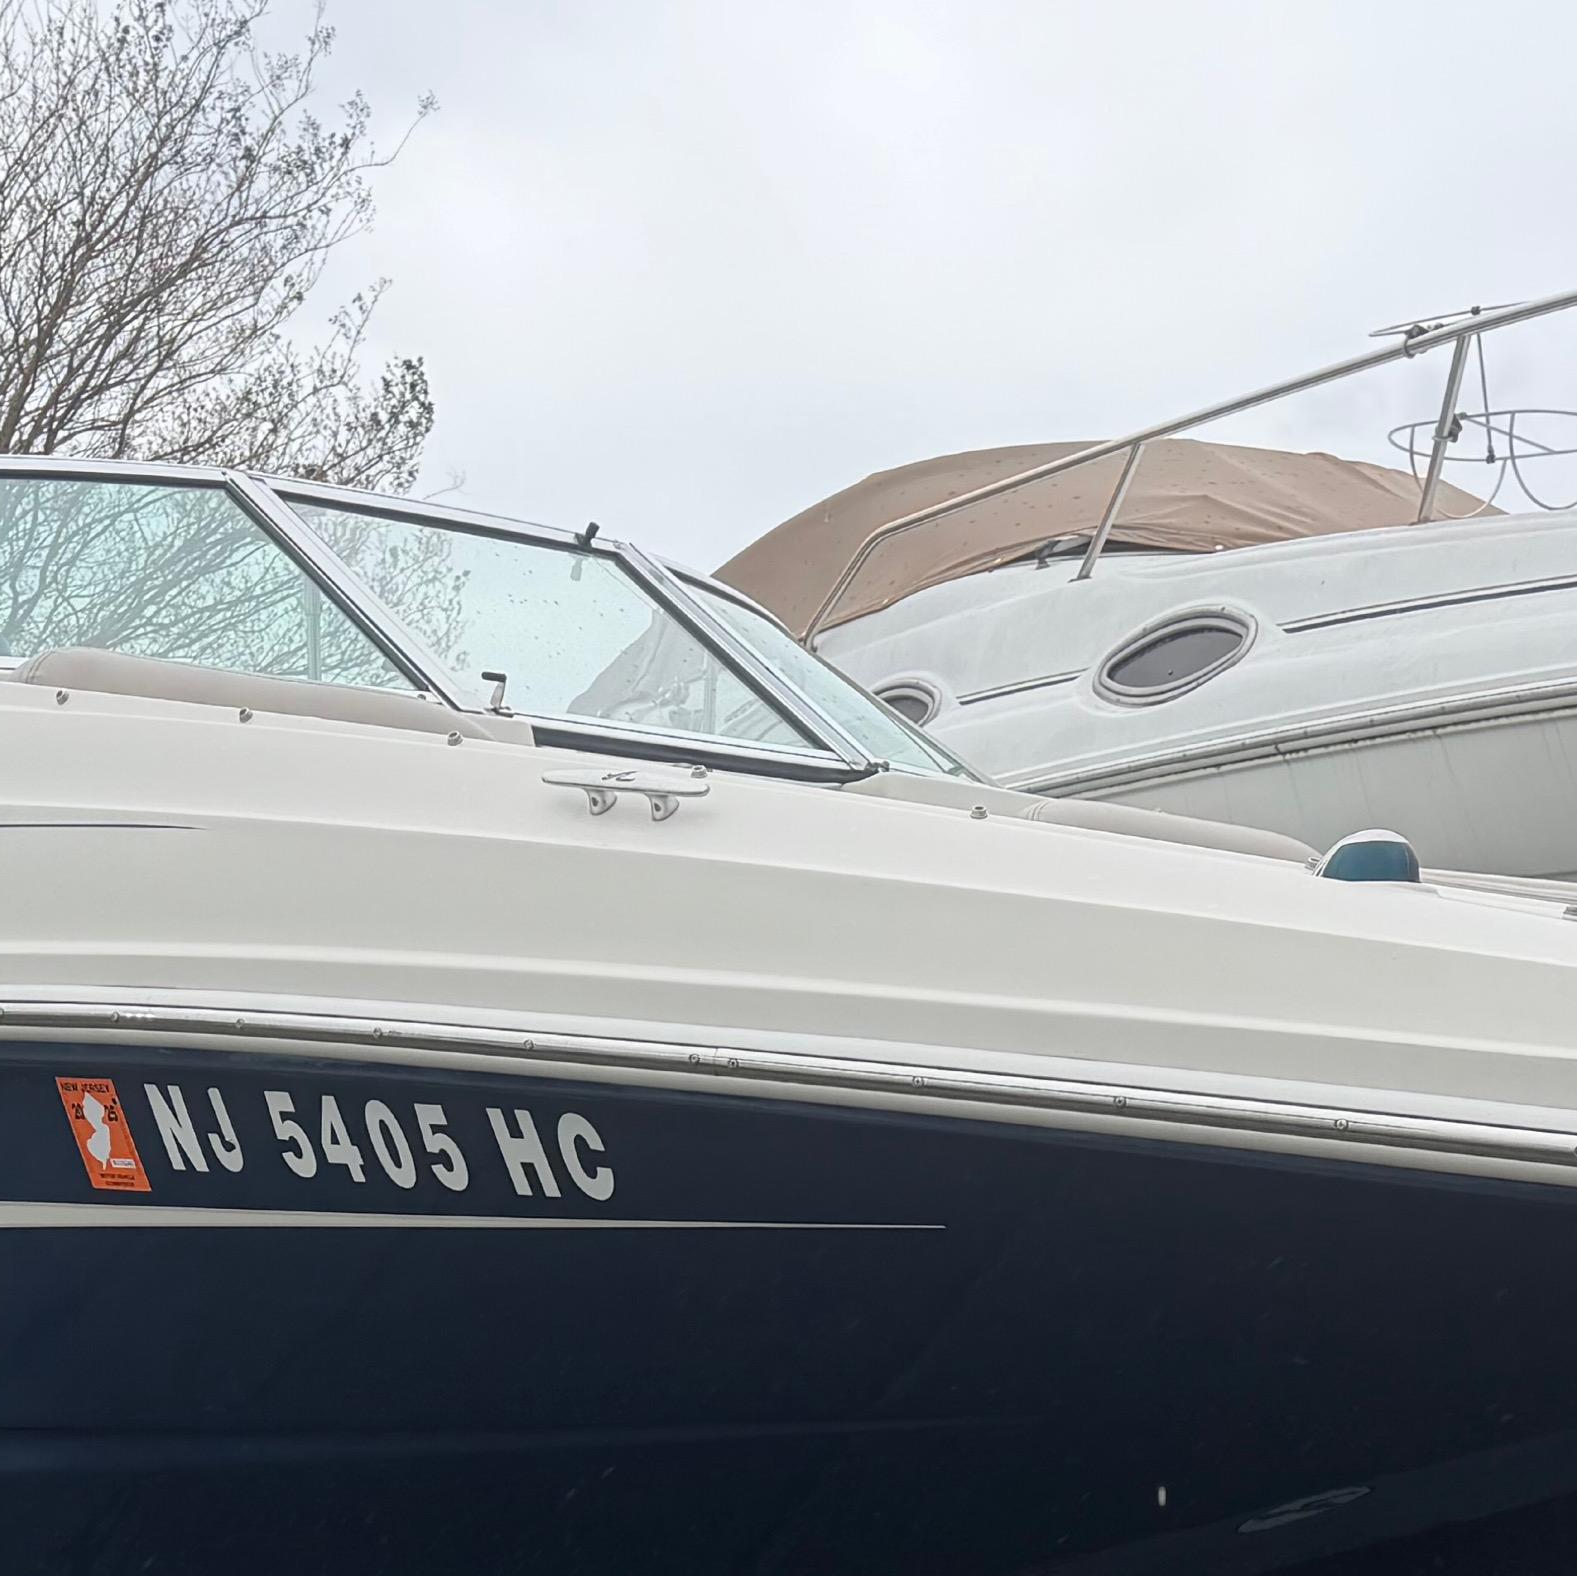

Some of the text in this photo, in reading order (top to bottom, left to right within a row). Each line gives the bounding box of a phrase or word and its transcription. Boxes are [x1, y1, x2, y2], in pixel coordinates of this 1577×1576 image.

[81, 1083, 110, 1092] JERSEY
[143, 1083, 615, 1201] NJ 5405 HC
